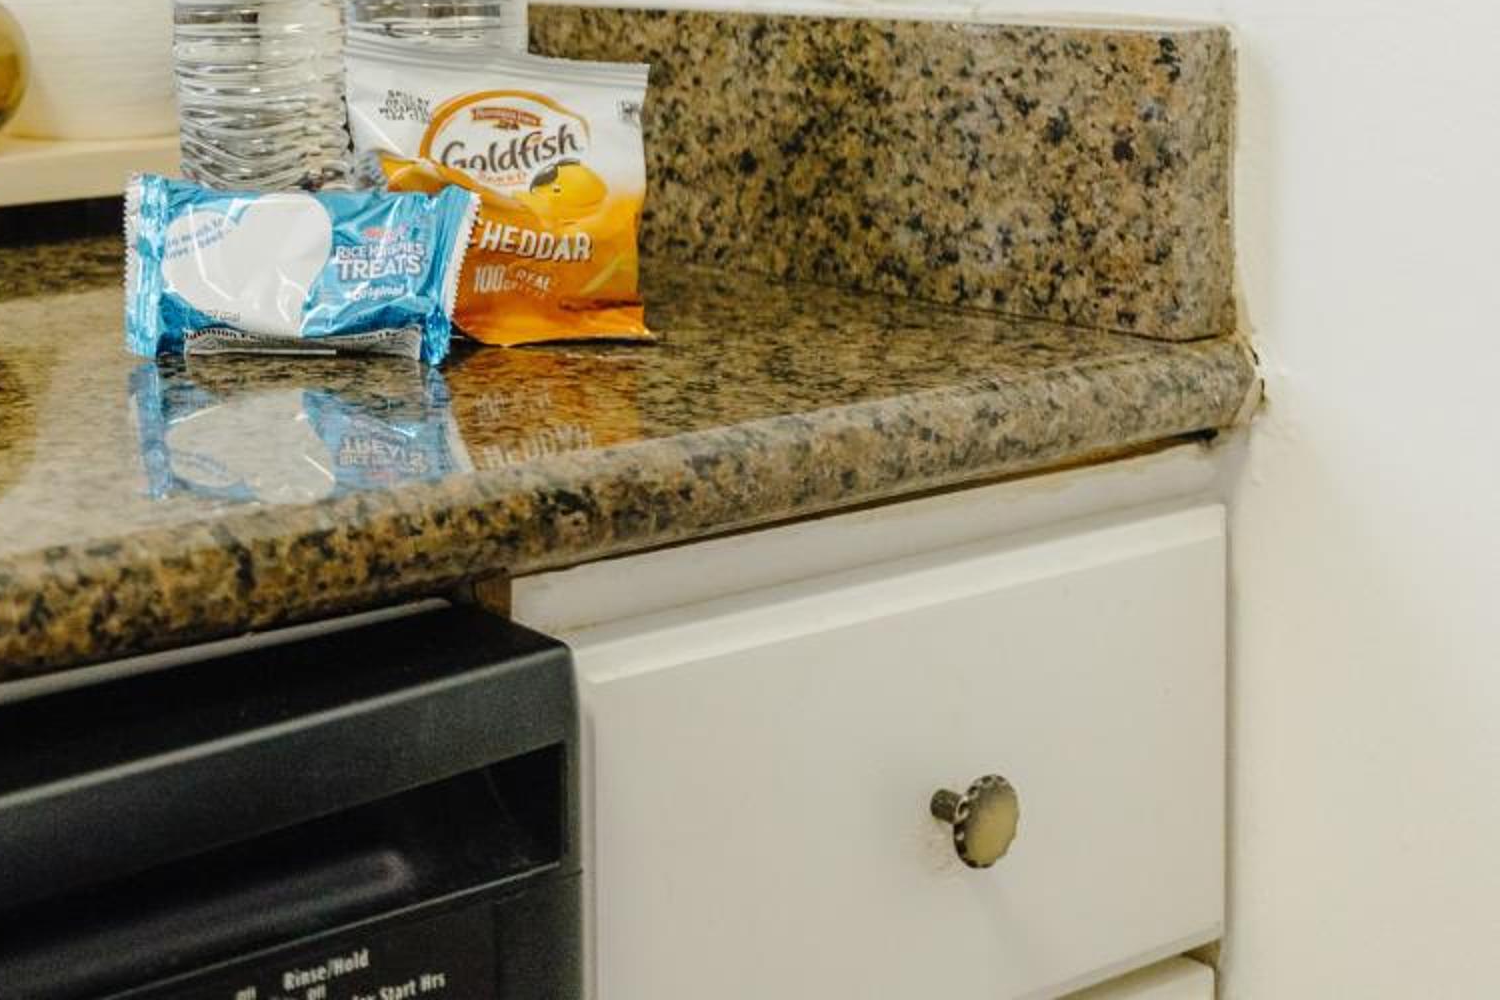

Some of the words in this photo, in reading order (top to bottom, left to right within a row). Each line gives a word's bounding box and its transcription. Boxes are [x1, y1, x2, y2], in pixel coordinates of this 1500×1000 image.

[441, 123, 578, 173] Goldfish
[472, 217, 591, 262] HEDDAR
[340, 254, 421, 280] TREATS
[282, 948, 369, 990] Rinse/Hold
[379, 980, 417, 1000] Start
[420, 972, 445, 991] Hrs
